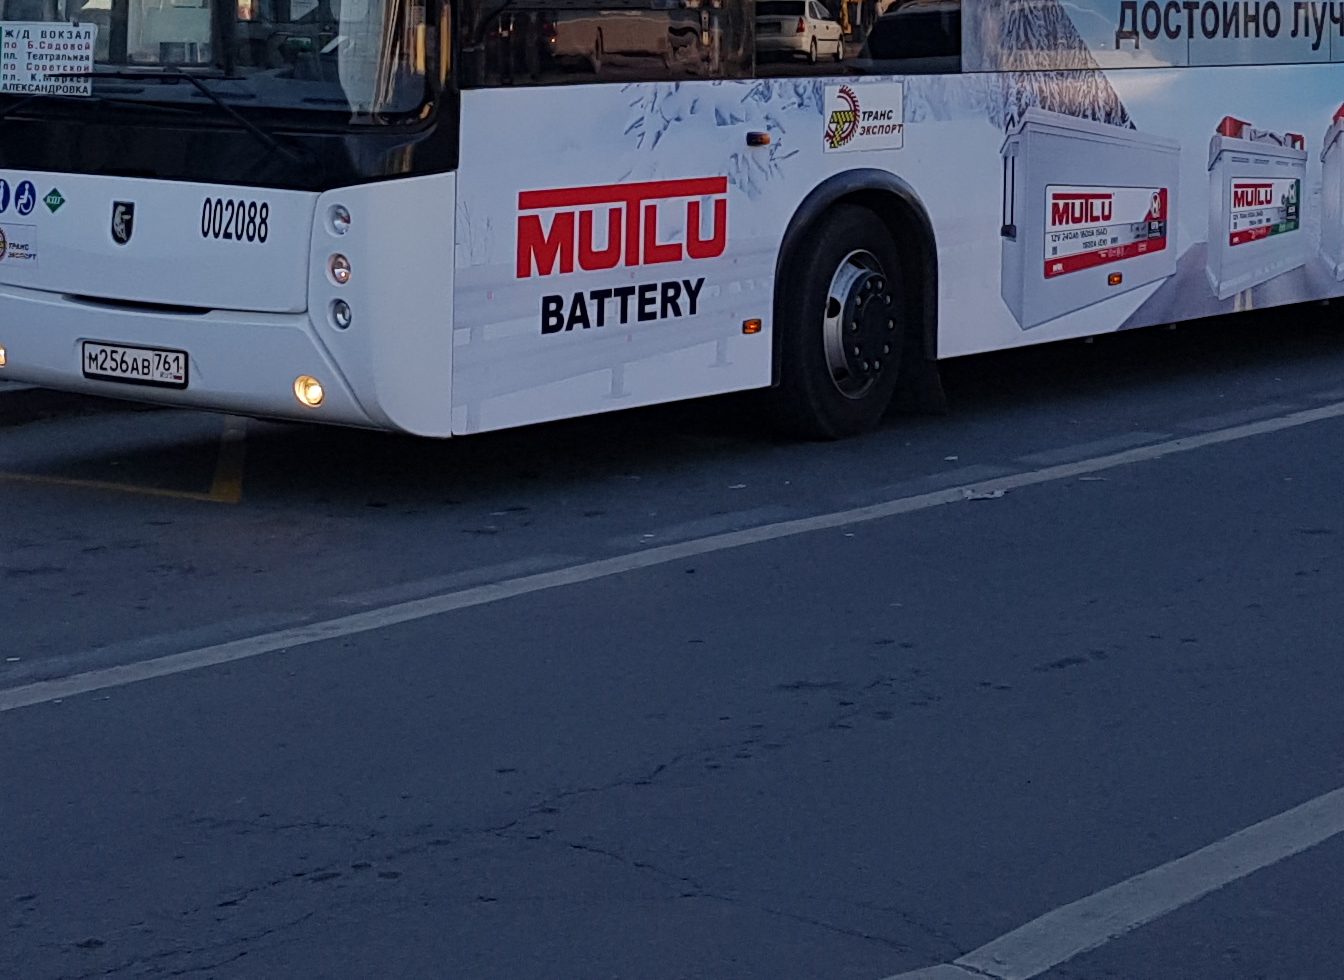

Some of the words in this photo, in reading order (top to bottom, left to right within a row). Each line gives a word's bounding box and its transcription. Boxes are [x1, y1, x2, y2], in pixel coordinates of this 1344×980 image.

[5, 29, 30, 40] Ж/Д
[41, 30, 91, 40] ВОКЗАЛ
[27, 40, 90, 50] Б.Садовой
[3, 51, 18, 60] пл.
[26, 51, 90, 62] Театральная
[26, 62, 90, 72] Советской
[3, 74, 20, 82] пл.
[2, 83, 89, 94] АЛЕКСАНДРОВКА
[861, 110, 893, 122] ТРАНС
[859, 123, 904, 136] ЭКСПОРТ
[1233, 183, 1273, 208] MUTLU
[1051, 193, 1112, 227] MUTLU
[201, 197, 269, 243] 002088
[516, 176, 728, 279] MUTLU
[541, 278, 705, 335] BATTERY
[154, 353, 180, 373] 761
